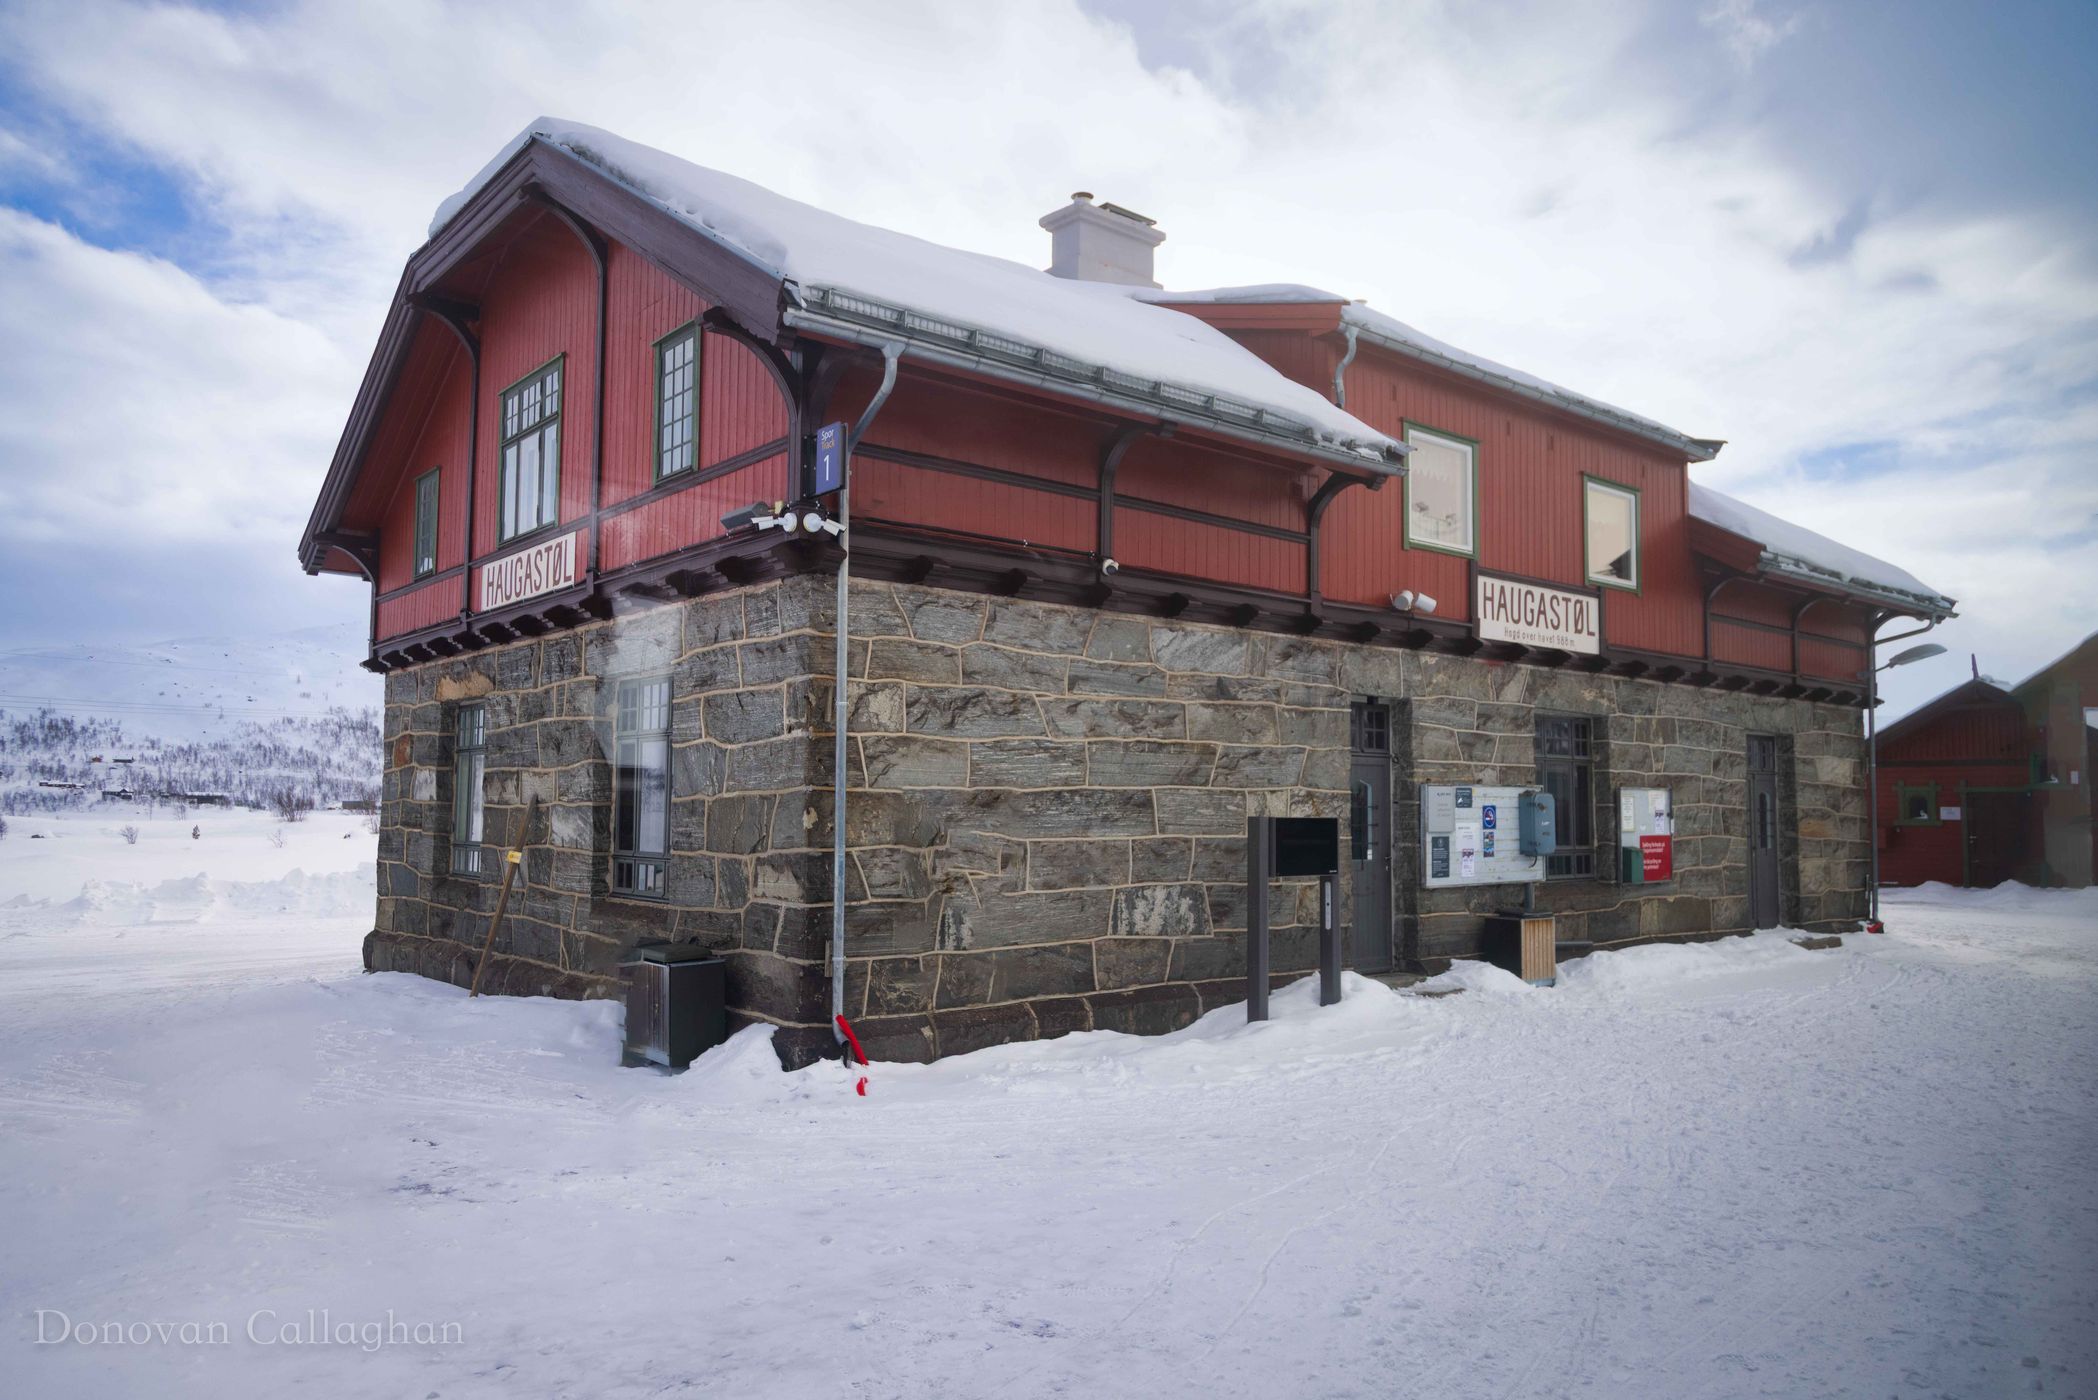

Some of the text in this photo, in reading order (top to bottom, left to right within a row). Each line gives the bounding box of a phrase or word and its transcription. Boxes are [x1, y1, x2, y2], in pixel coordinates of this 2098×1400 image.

[821, 429, 834, 441] Spor
[823, 454, 830, 481] 1
[486, 539, 572, 607] HAUGASTØL
[1483, 581, 1595, 636] HAUGASTØL
[1521, 631, 1536, 641] over
